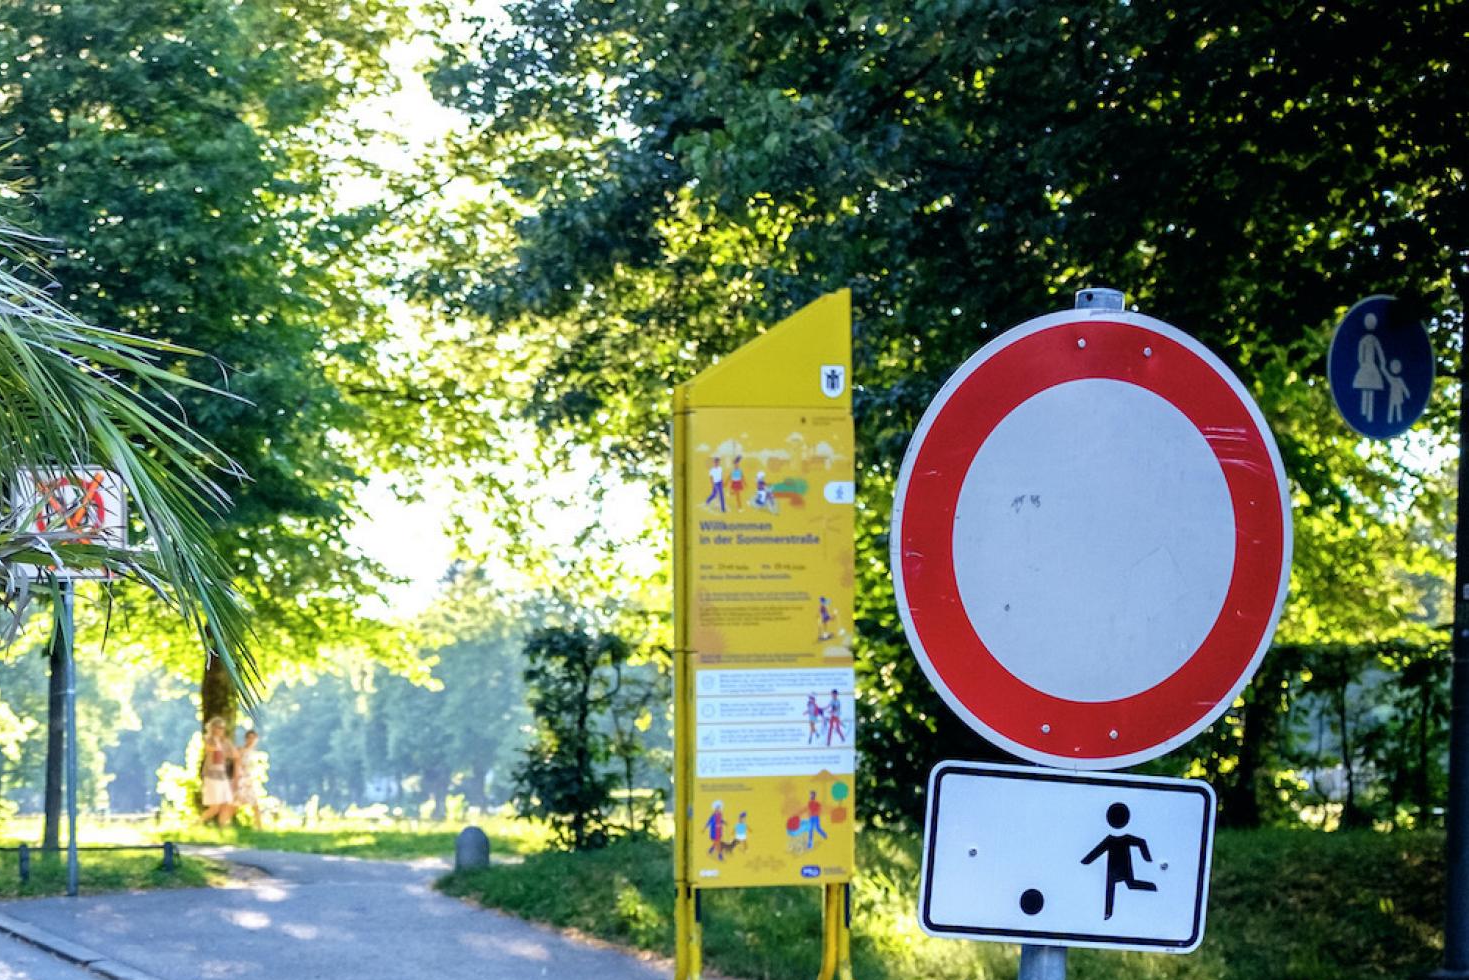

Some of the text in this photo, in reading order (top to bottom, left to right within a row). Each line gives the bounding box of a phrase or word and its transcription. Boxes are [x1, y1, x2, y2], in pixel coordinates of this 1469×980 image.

[700, 520, 772, 531] Willkommen
[700, 534, 820, 544] in der Sommerstraße
